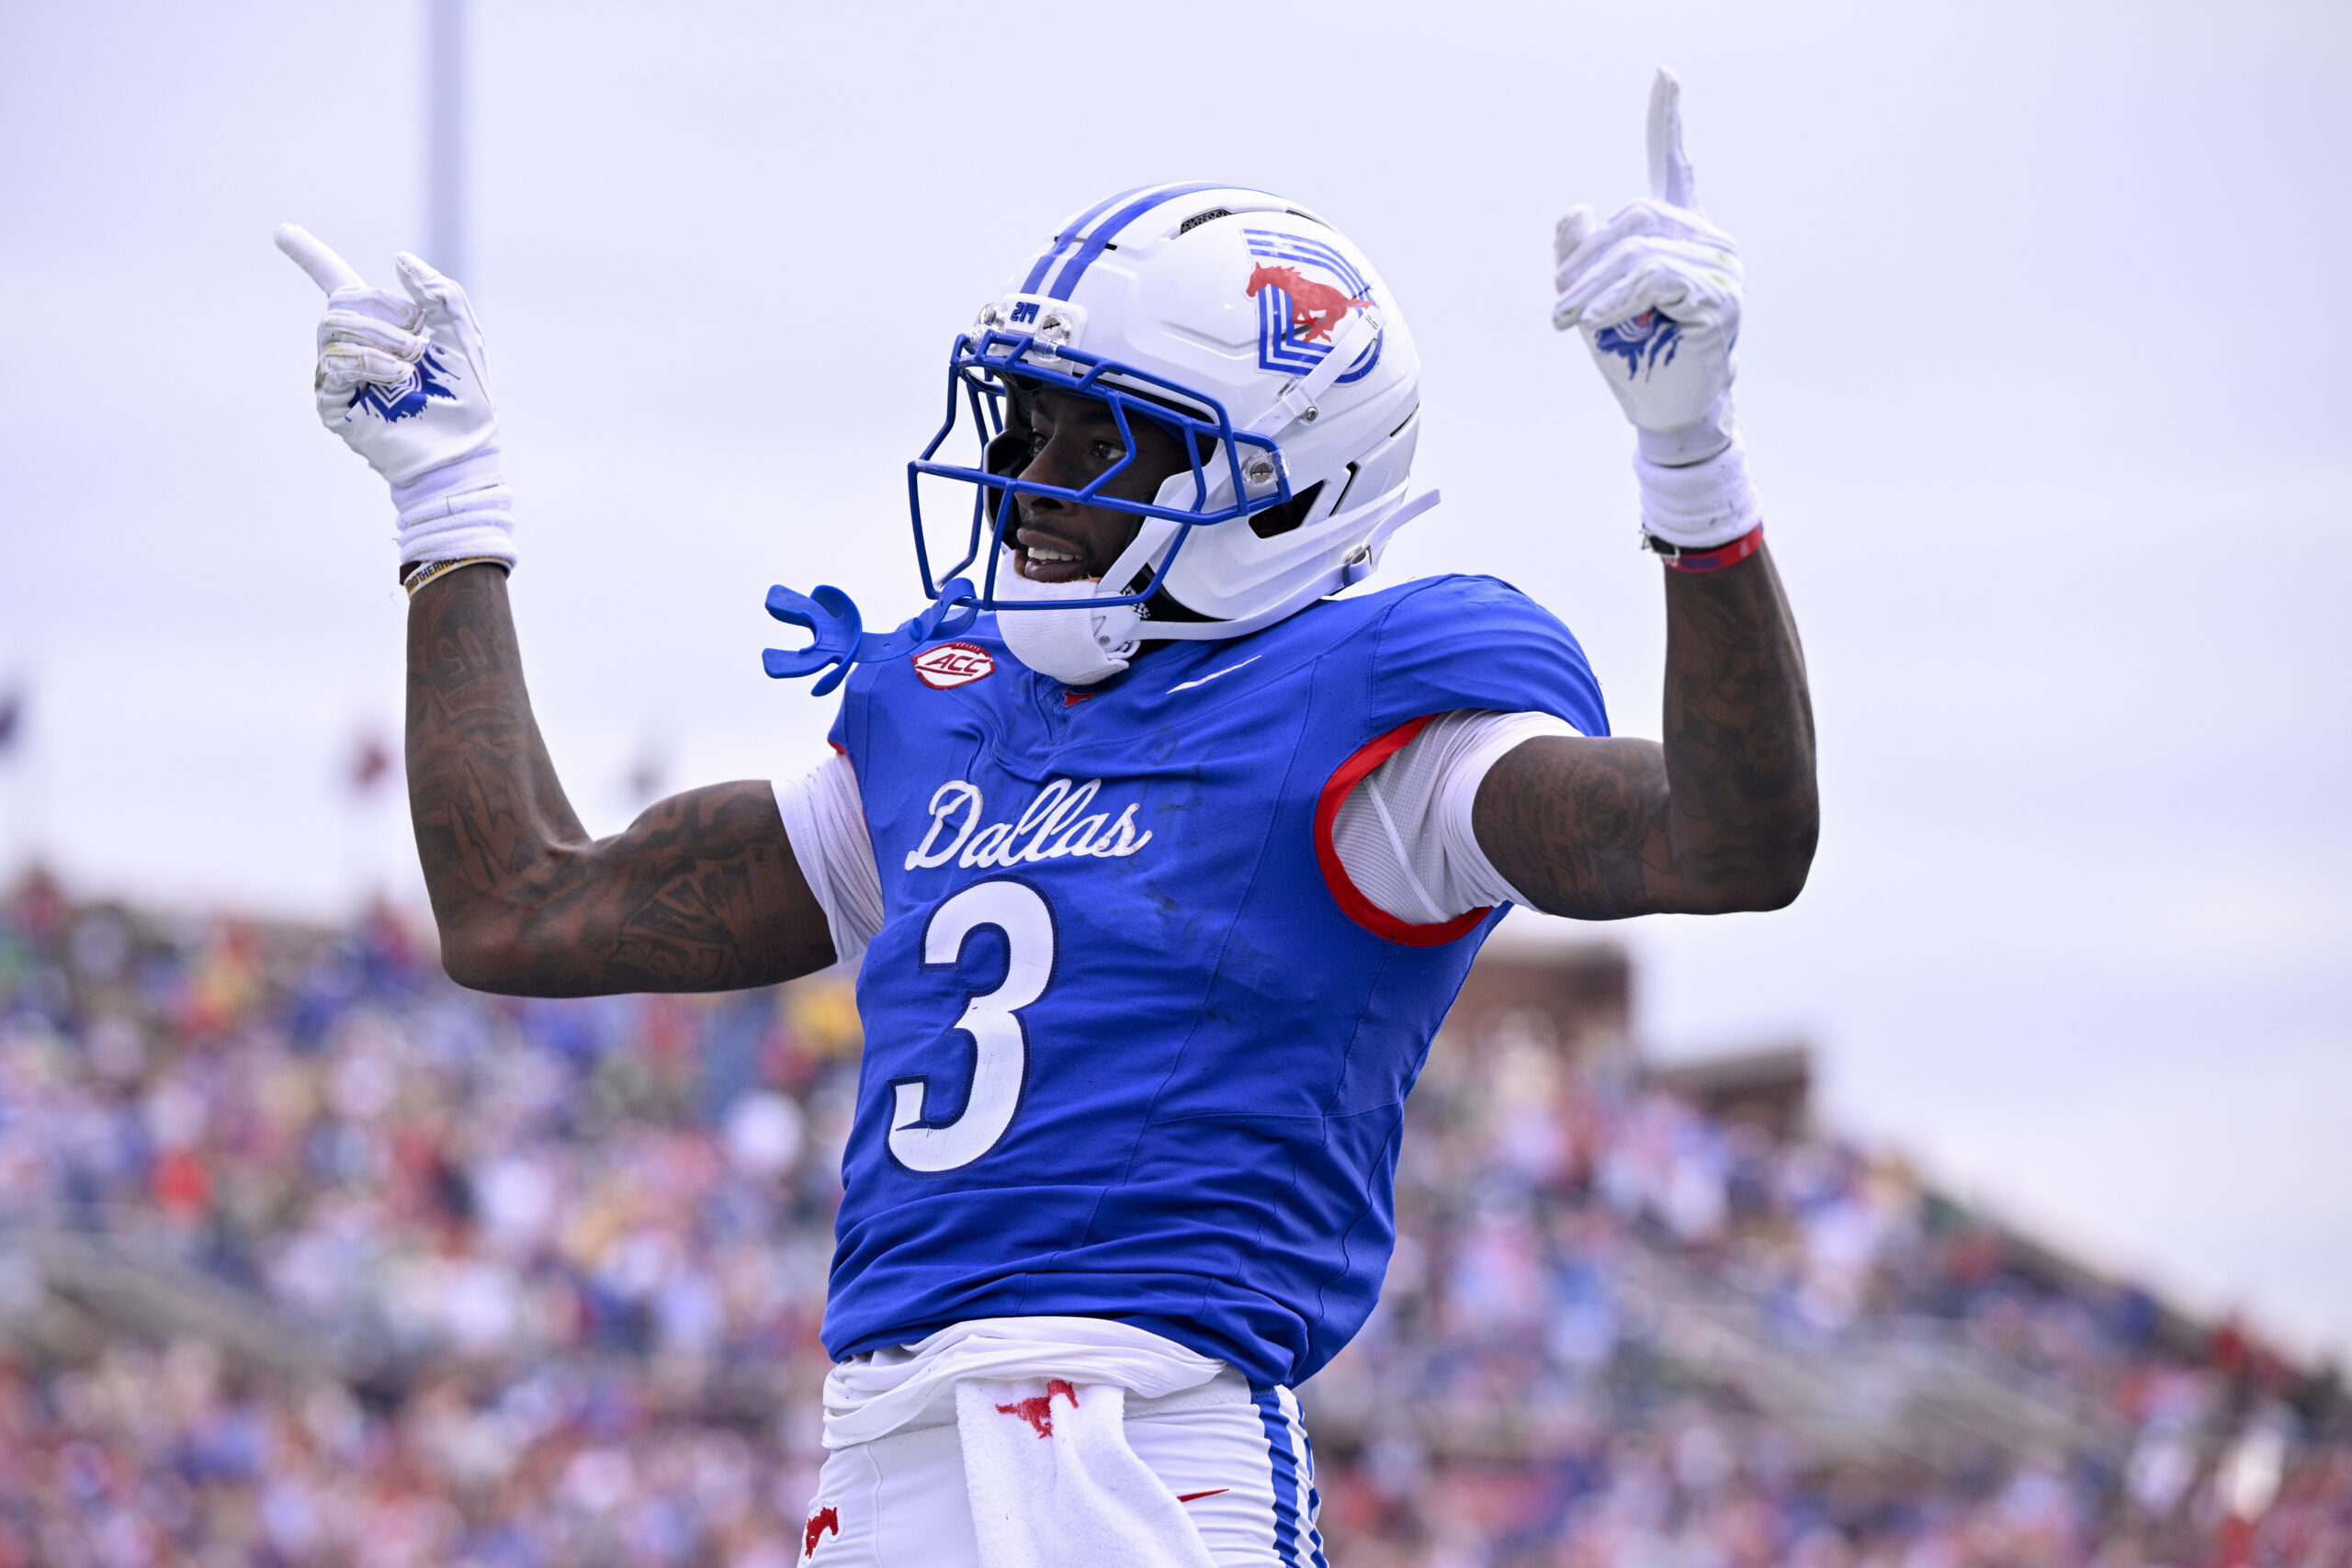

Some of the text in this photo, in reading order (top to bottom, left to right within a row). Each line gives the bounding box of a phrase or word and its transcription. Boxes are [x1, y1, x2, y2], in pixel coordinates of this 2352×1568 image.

[924, 653, 991, 673] ACC
[905, 779, 1152, 871] Dallas
[883, 873, 1060, 1179] 3
